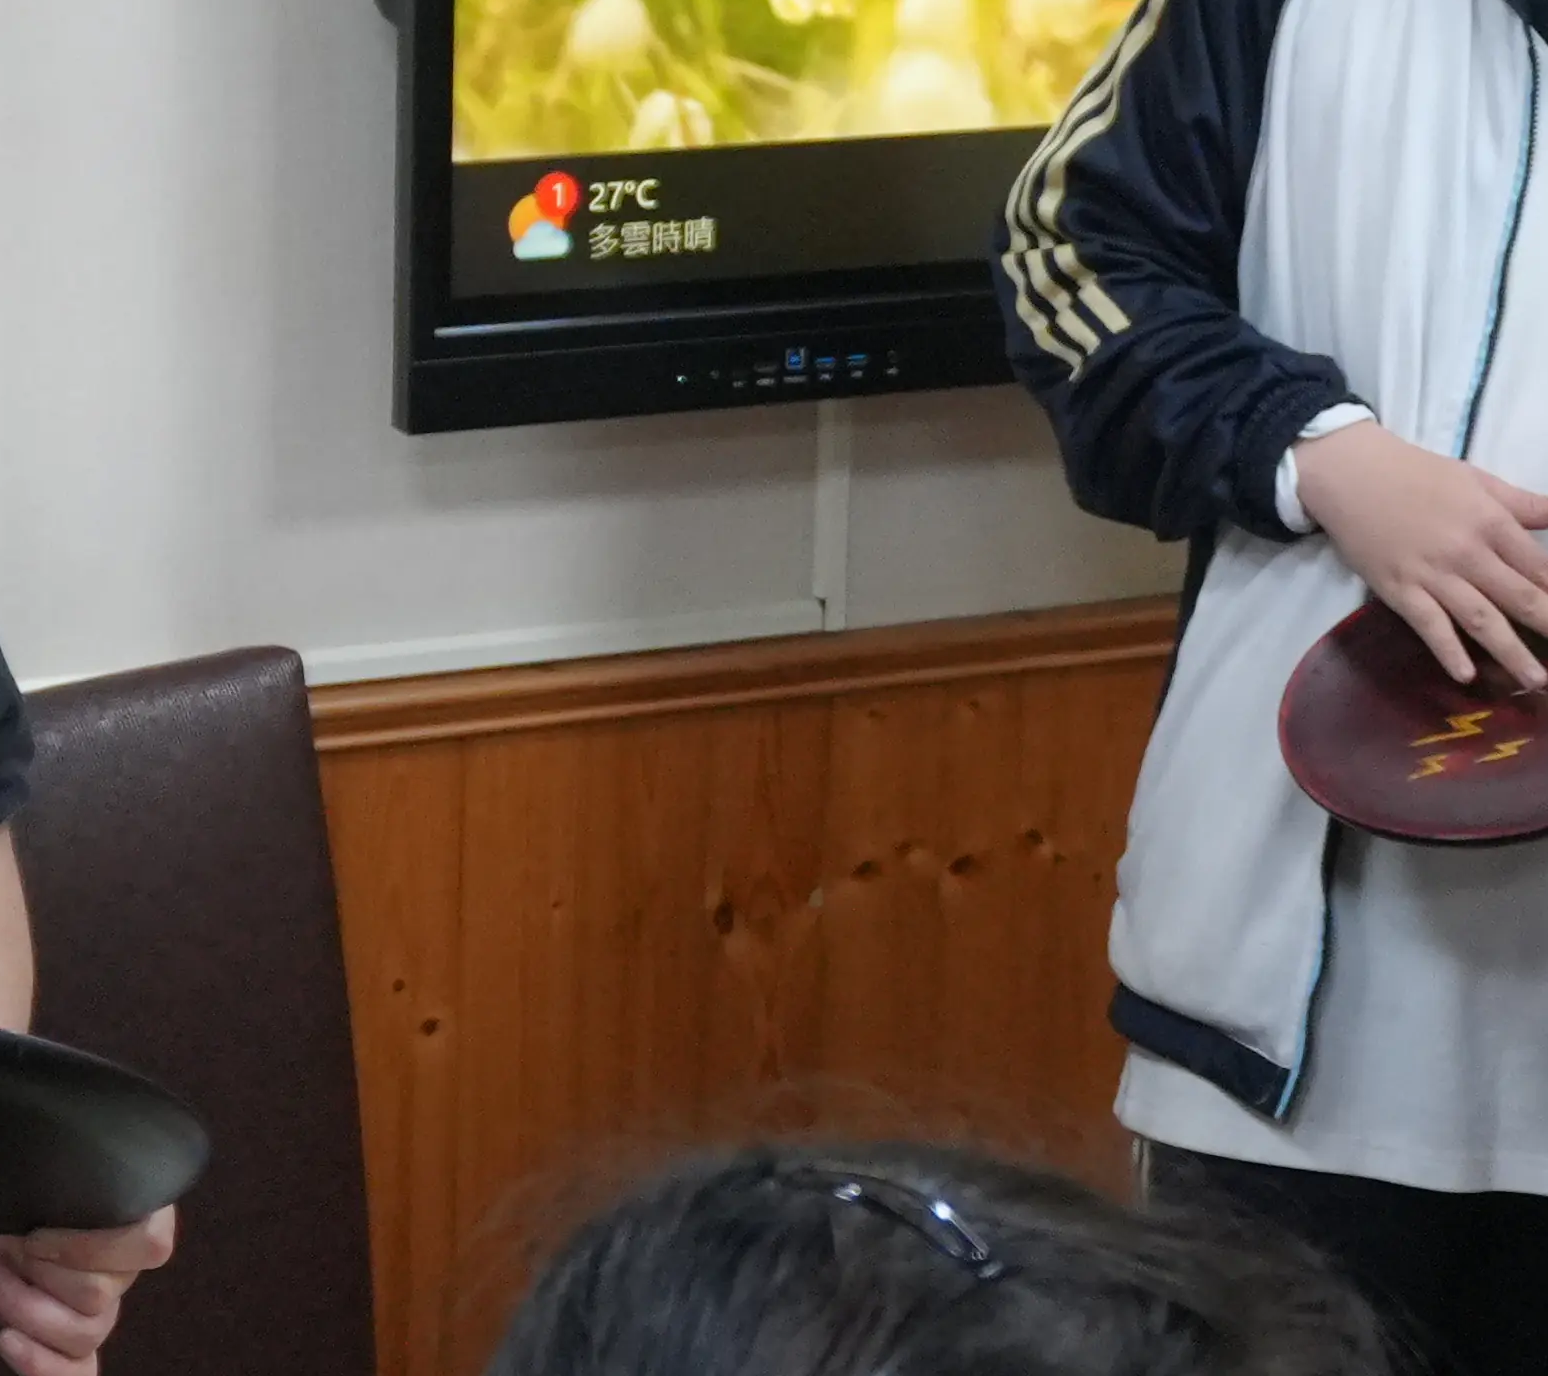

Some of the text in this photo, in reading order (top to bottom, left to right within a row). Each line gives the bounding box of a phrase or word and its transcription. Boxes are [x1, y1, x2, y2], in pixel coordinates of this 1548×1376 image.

[552, 179, 660, 214] 1 27°C
[588, 215, 717, 260] 多雲時晴
